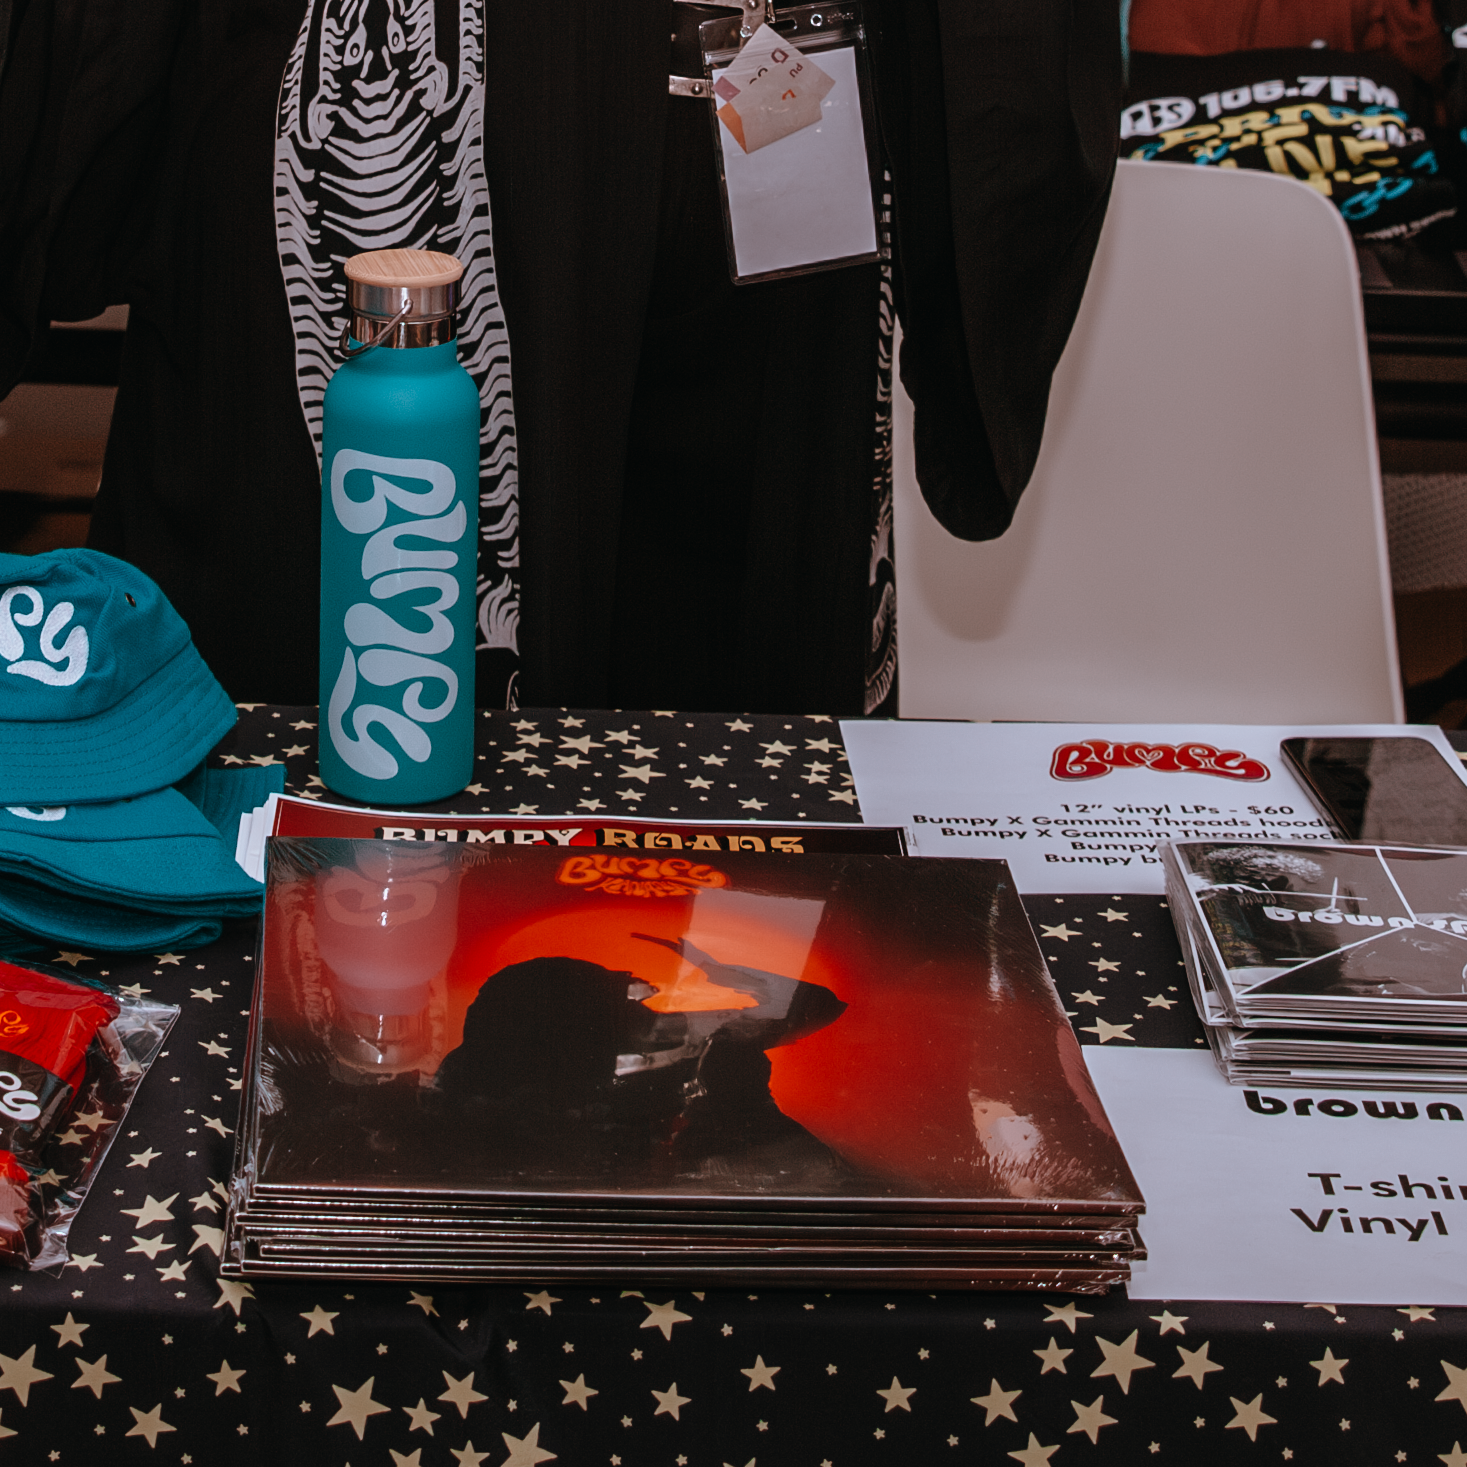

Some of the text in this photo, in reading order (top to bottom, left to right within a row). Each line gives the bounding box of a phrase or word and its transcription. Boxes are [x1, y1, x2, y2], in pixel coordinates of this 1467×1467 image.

[1198, 75, 1400, 119] 106.7FM
[1112, 803, 1295, 818] vinyl LPs $60
[912, 814, 1252, 829] Bumpy X Gammin Threads
[381, 826, 584, 846] BUMPY
[940, 827, 1282, 841] Bumpy X Gammin Threads
[1071, 840, 1157, 854] Bumpy
[1043, 852, 1132, 867] Bumpy
[1262, 905, 1416, 929] brown
[1242, 1089, 1464, 1122] brown
[1290, 1206, 1449, 1242] Vinyl
